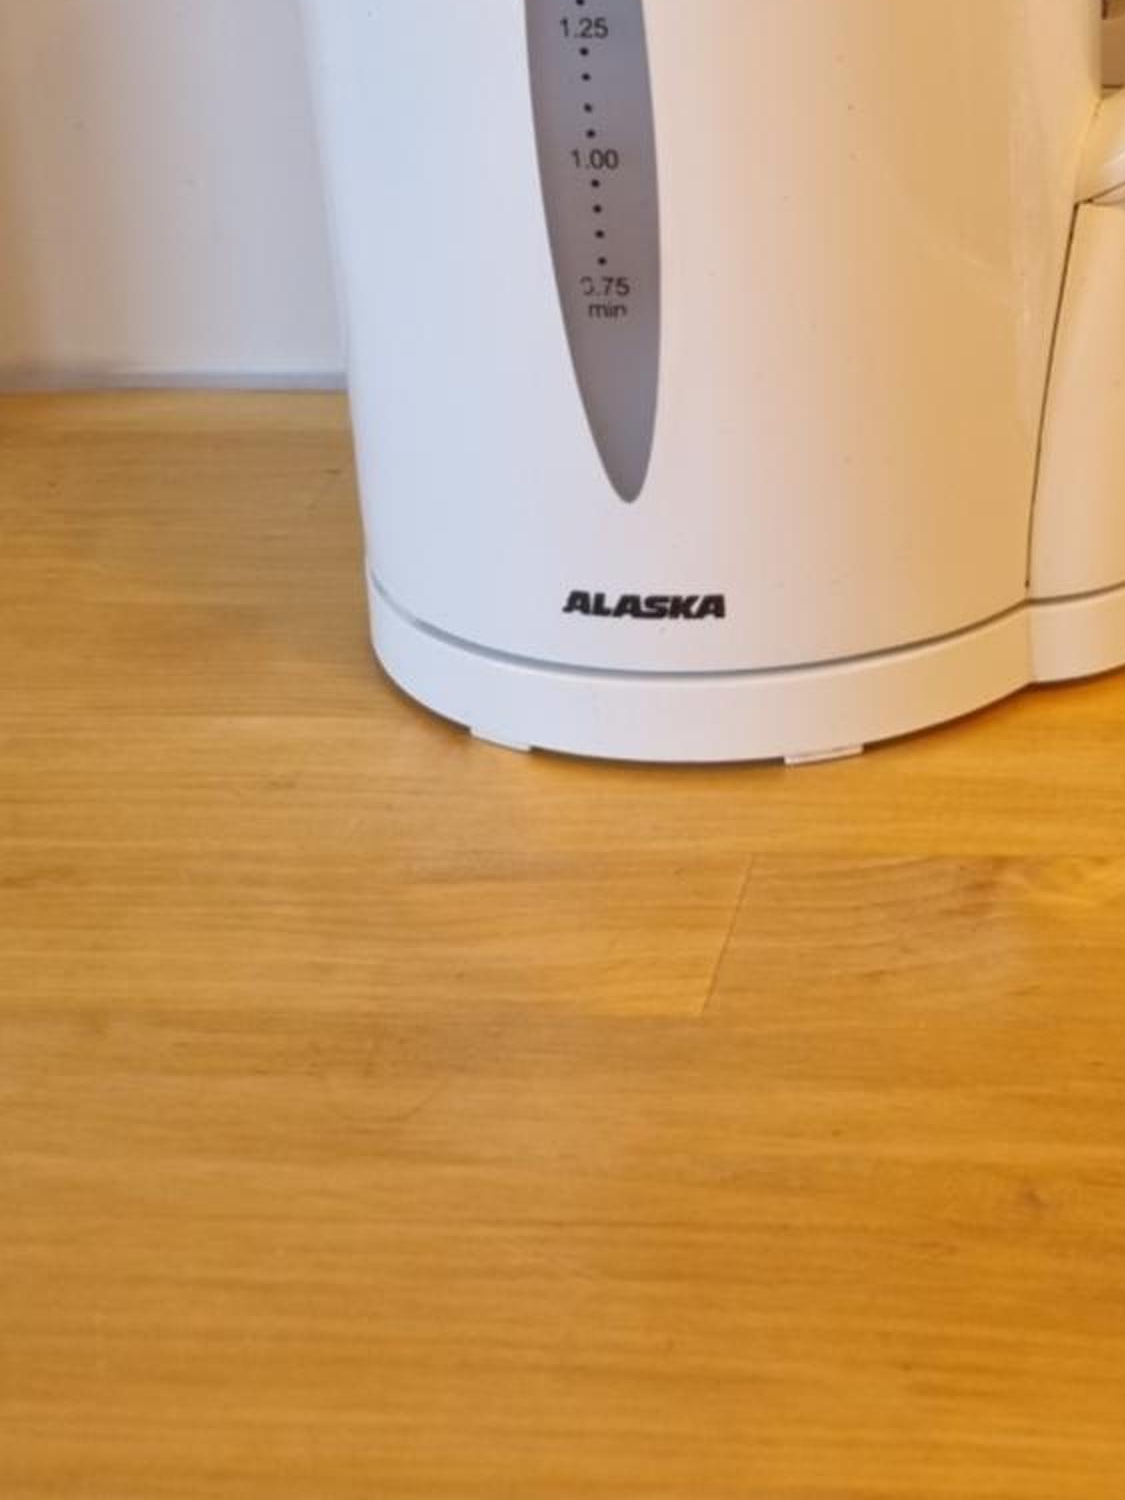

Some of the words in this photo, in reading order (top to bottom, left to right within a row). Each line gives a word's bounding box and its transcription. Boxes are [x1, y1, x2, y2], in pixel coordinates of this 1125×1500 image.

[559, 17, 609, 39] 1.25
[571, 148, 620, 170] 1.00
[588, 301, 628, 320] min
[562, 590, 726, 620] ALASKA
